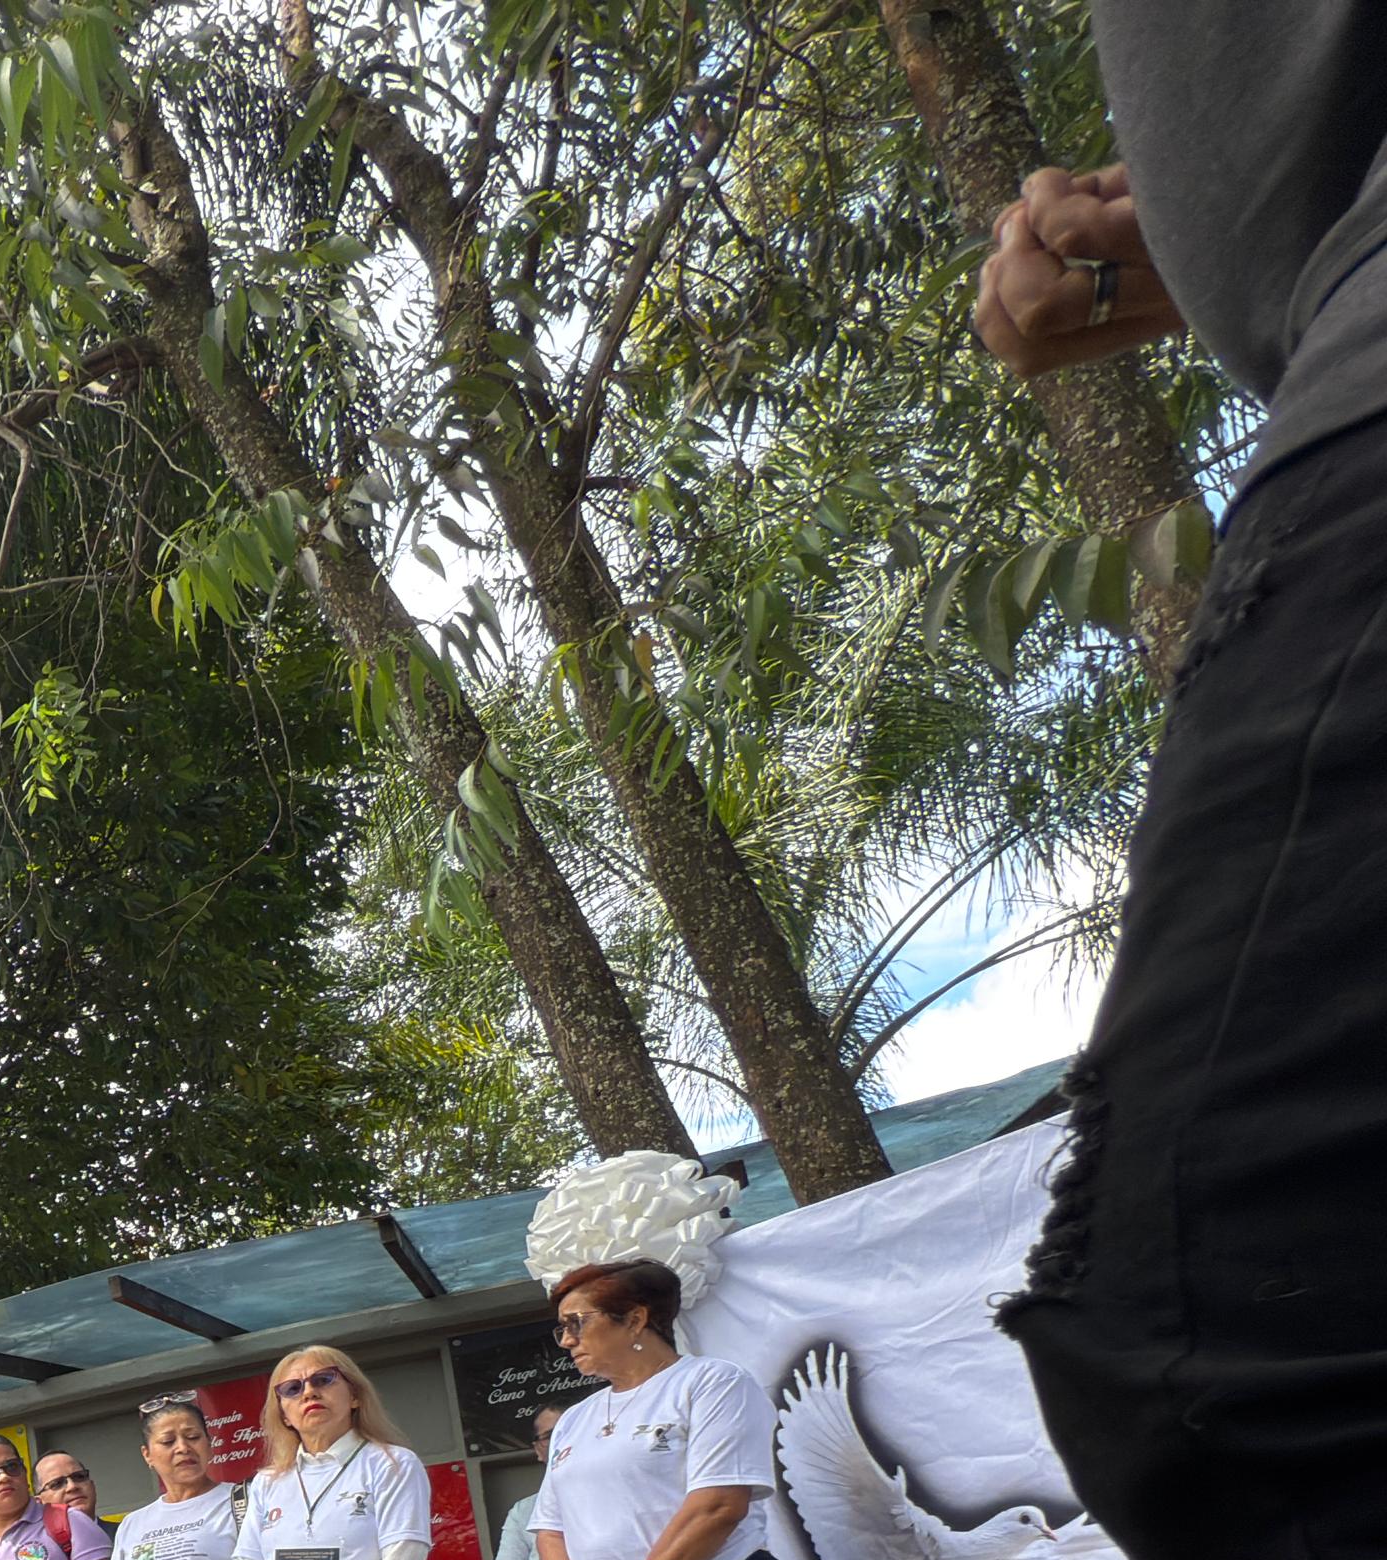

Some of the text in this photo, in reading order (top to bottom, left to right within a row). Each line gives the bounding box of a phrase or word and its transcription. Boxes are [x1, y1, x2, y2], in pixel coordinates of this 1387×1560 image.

[492, 1367, 537, 1387] Jorge
[487, 1388, 526, 1404] Cano
[204, 1410, 243, 1429] oaquín
[141, 1518, 204, 1541] DESAPARECIDO
